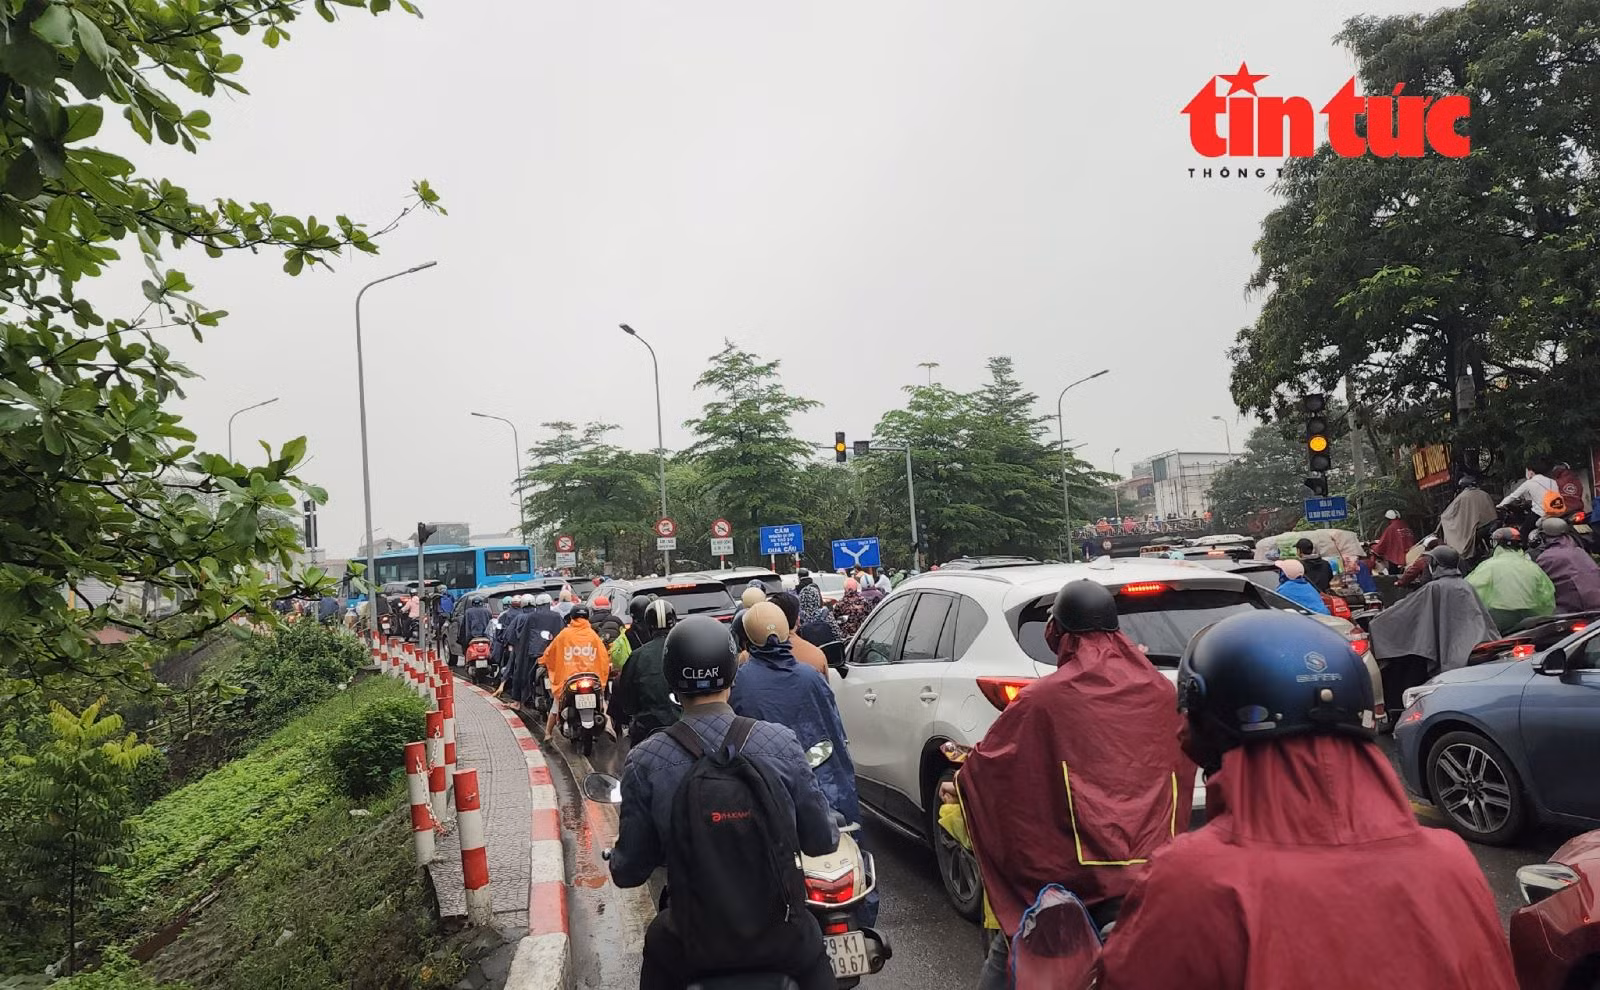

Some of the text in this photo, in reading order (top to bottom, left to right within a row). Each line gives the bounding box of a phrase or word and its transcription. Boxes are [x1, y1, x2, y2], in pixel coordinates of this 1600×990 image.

[564, 642, 597, 661] yody
[682, 666, 719, 679] CLEAR
[825, 935, 858, 955] 9-K1
